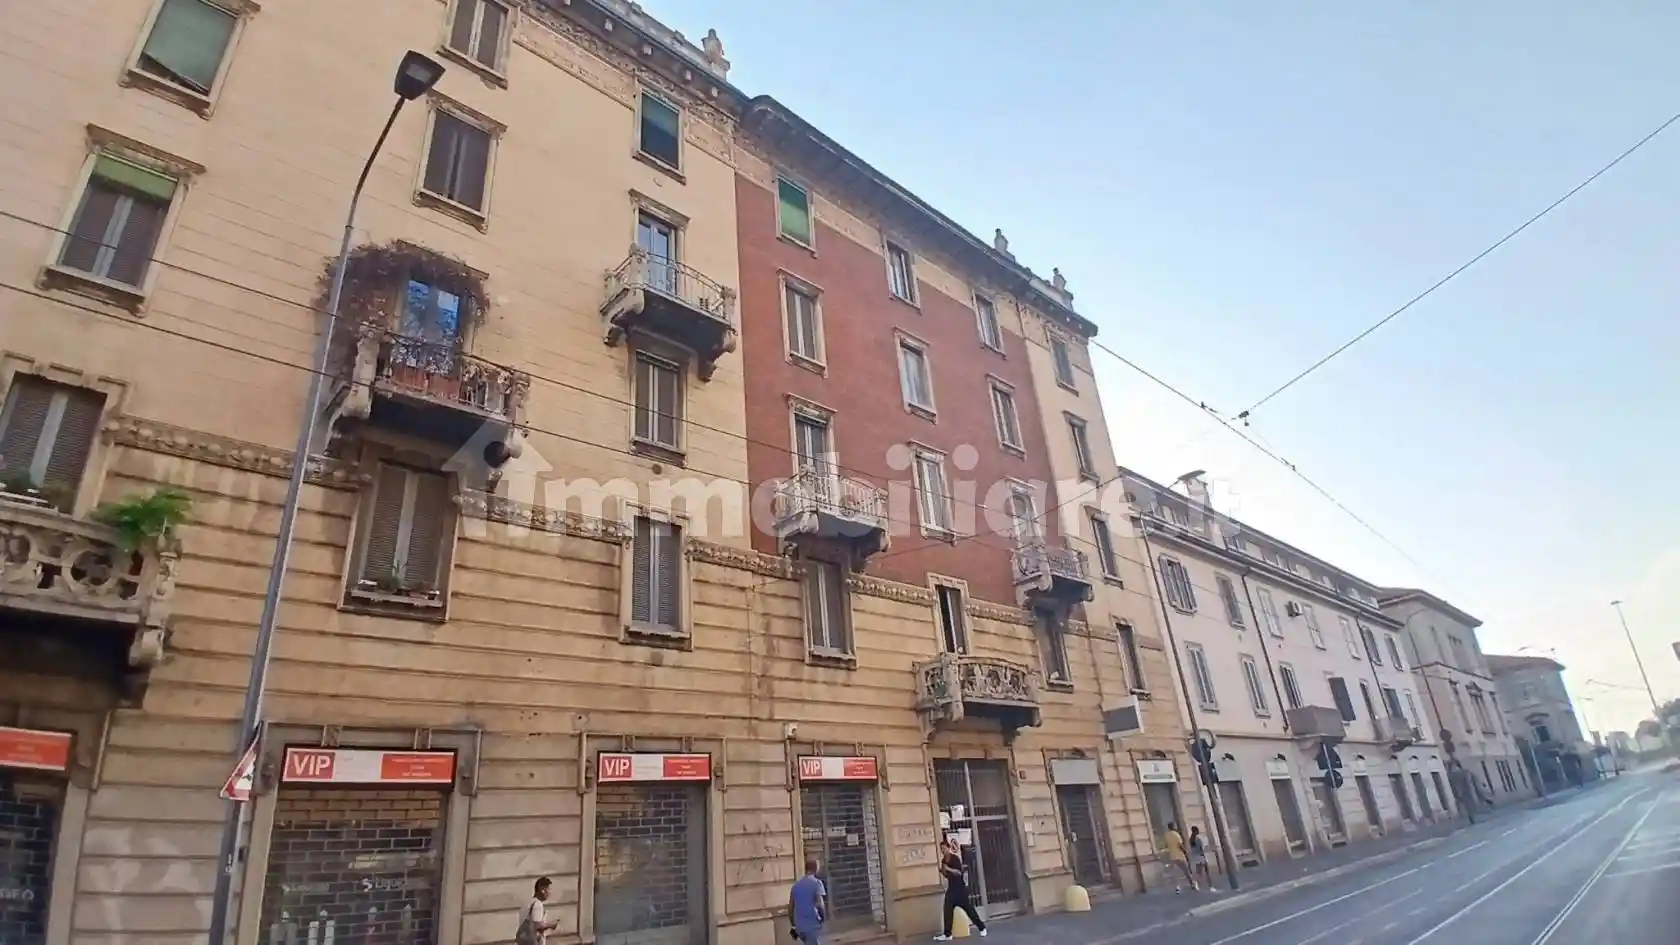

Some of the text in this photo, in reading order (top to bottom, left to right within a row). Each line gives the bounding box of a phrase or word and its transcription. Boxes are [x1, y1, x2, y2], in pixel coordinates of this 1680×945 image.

[292, 755, 331, 776] VIP
[604, 759, 630, 776] VIP
[802, 760, 821, 774] VIP
